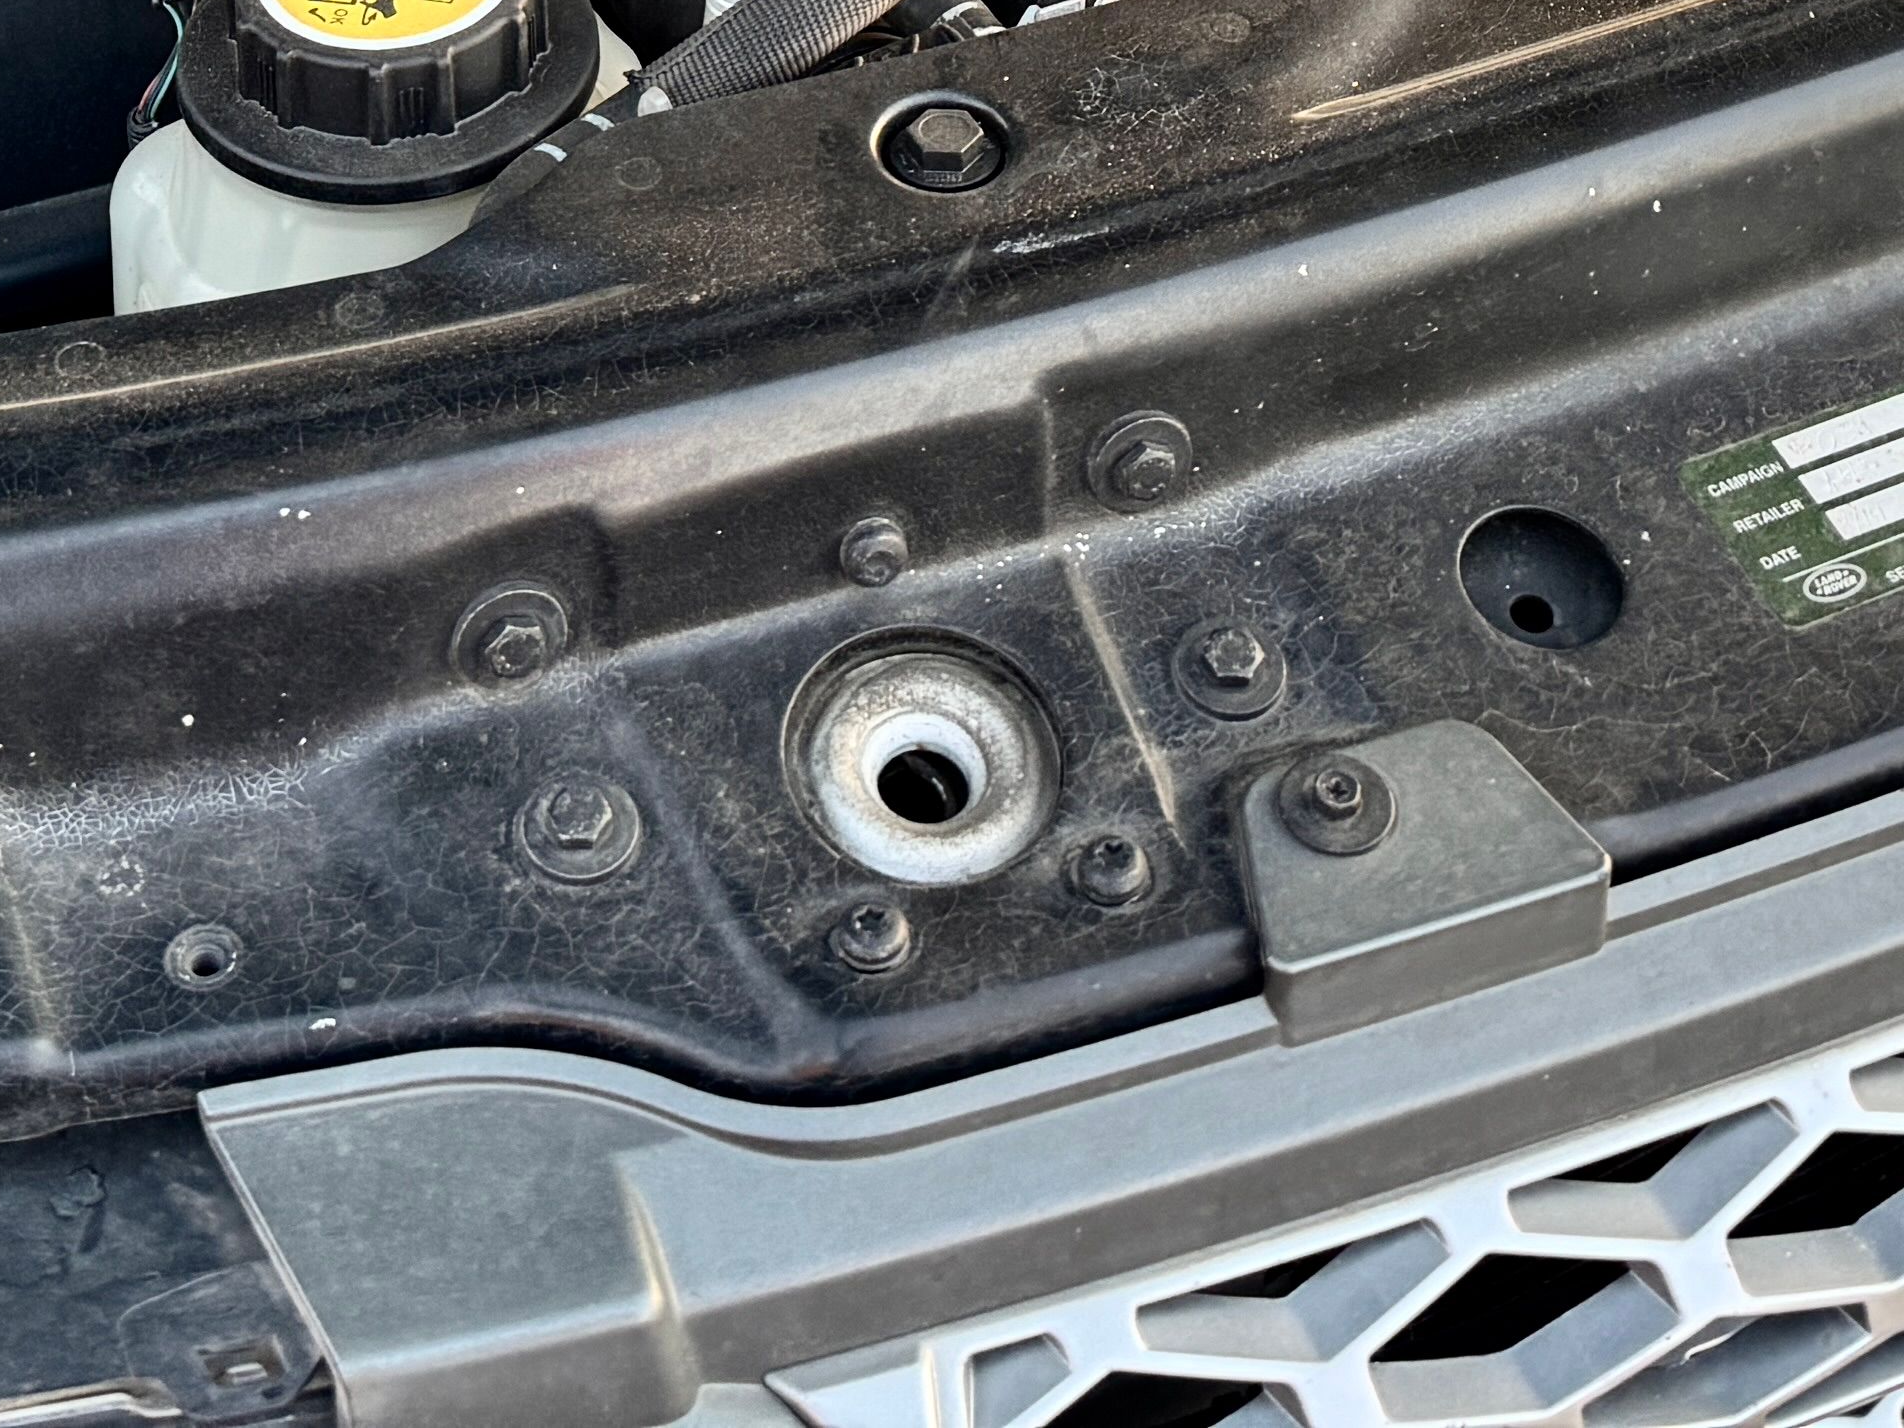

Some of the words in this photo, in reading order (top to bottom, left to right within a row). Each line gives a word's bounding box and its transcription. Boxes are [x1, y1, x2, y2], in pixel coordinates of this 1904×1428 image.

[330, 9, 348, 25] OK
[1707, 461, 1784, 498] CAMPAIGN
[1733, 499, 1805, 533] RETAILER
[1759, 546, 1802, 570] DATE
[1814, 570, 1844, 588] LAND
[1824, 575, 1858, 596] ROVER
